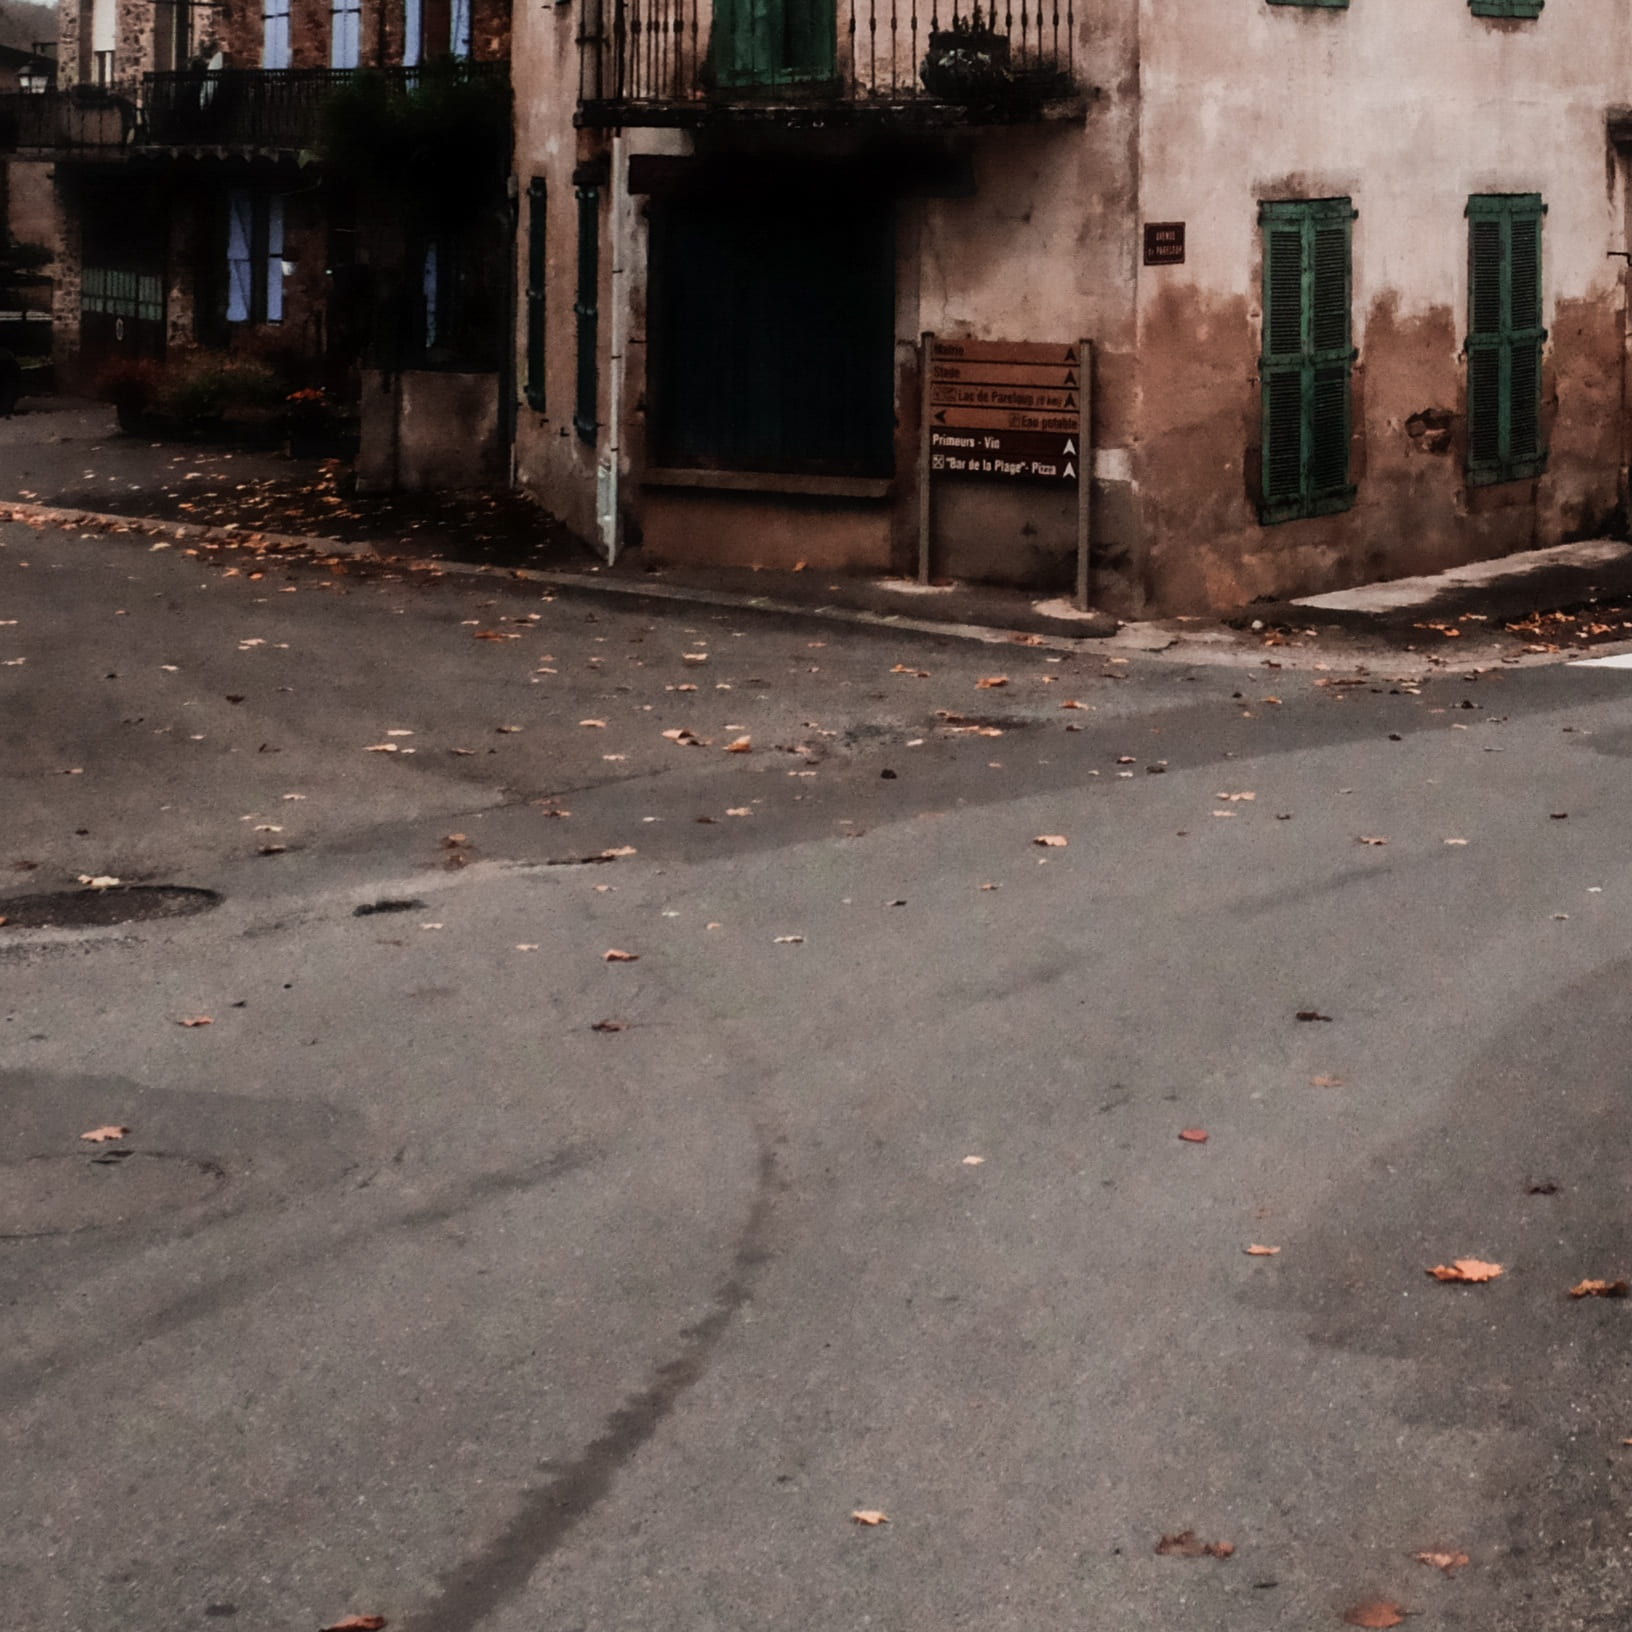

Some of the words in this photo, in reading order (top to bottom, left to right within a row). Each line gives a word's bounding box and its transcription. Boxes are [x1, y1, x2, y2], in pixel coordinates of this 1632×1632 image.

[933, 366, 961, 378] Stade
[958, 389, 974, 402] Lac
[976, 389, 989, 402] de
[991, 390, 1034, 407] Pareloup
[1022, 415, 1039, 428] Eau
[1041, 417, 1078, 432] potable
[932, 432, 975, 448] Primeurs
[984, 435, 1000, 450] Vin
[968, 457, 981, 471] de
[982, 458, 992, 472] la
[1031, 460, 1057, 476] Pizza
